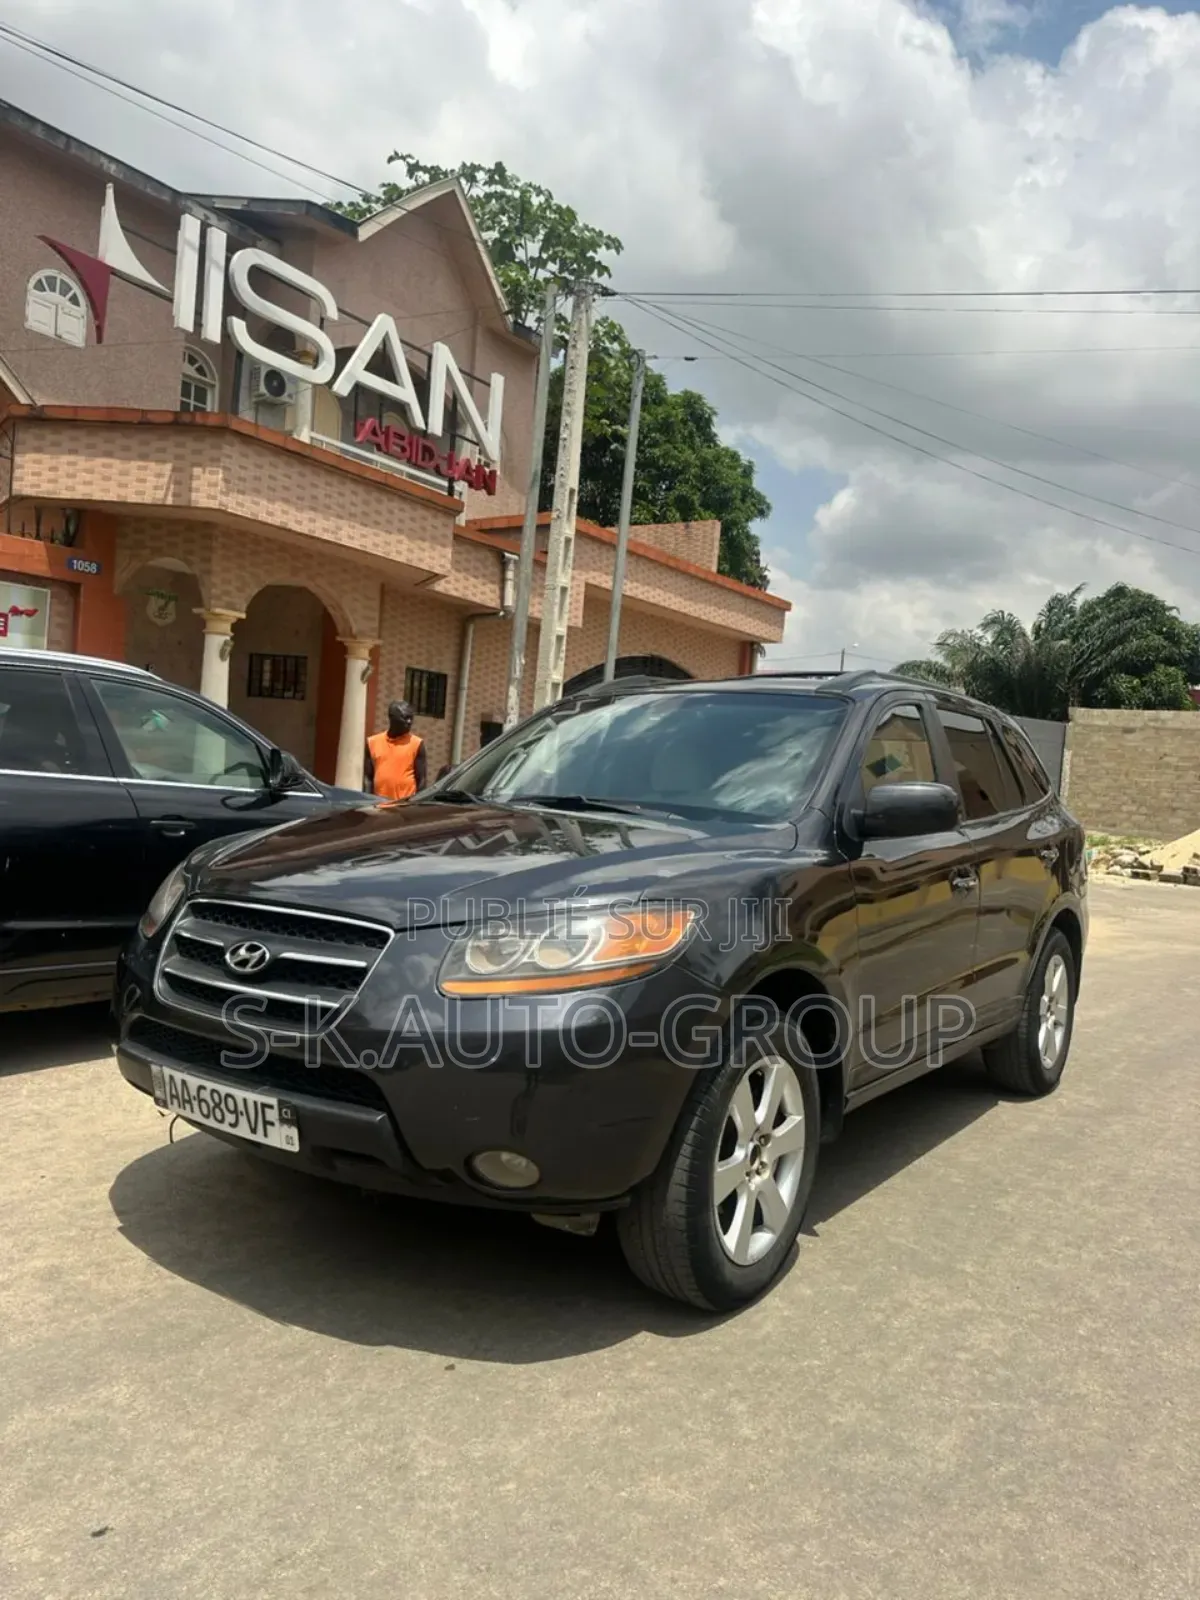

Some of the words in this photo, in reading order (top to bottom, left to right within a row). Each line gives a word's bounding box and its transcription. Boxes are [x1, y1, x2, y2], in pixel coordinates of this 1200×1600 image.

[355, 417, 498, 496] ABIDJAN
[72, 559, 98, 574] 1058
[168, 1074, 276, 1138] AA-689-VF
